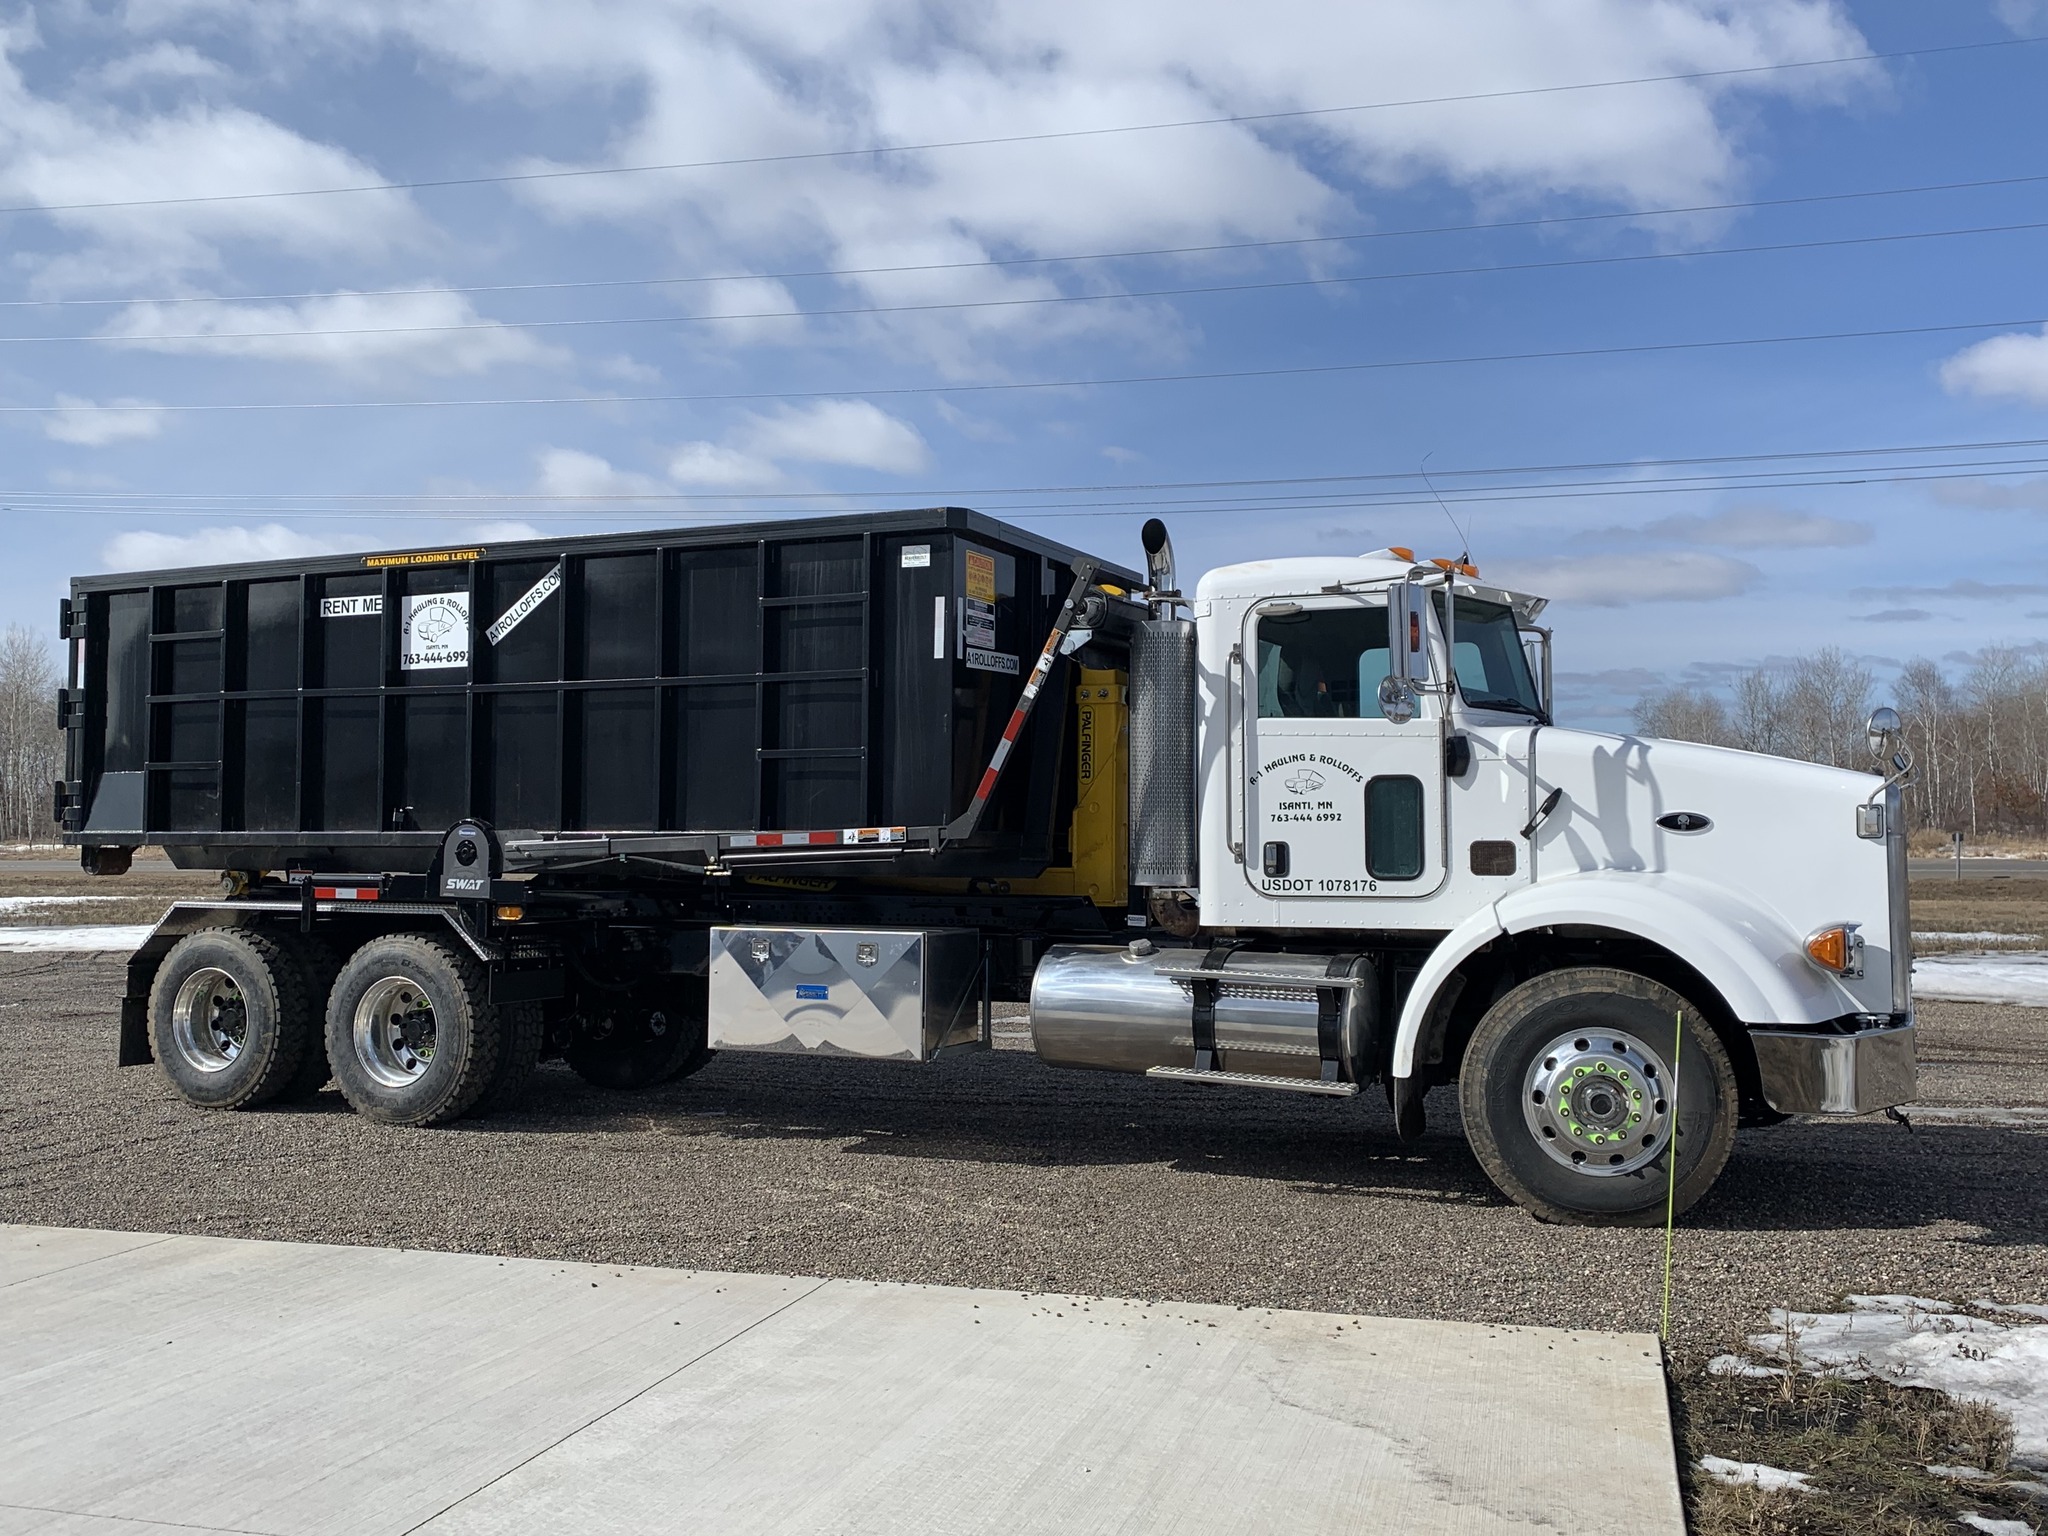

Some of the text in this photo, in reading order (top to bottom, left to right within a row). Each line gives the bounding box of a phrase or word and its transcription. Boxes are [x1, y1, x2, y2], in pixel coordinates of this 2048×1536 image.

[367, 552, 479, 567] MAXIMUM LOADING LEVEL
[323, 598, 382, 615] RENT ME
[403, 621, 411, 635] A-1
[408, 597, 437, 621] HAULING
[440, 597, 445, 605] &
[967, 652, 1018, 671] A1ROLLOFFS.COM
[1081, 711, 1092, 779] PALFINGER
[1250, 771, 1263, 785] A-1
[1264, 754, 1306, 772] HAULING
[1320, 755, 1363, 783] ROLLOFFS
[1279, 801, 1333, 810] ISANTI, MN
[1271, 813, 1342, 822] 763-444 6992
[446, 879, 484, 890] SWAT
[1262, 879, 1377, 892] USDOT 1078176
